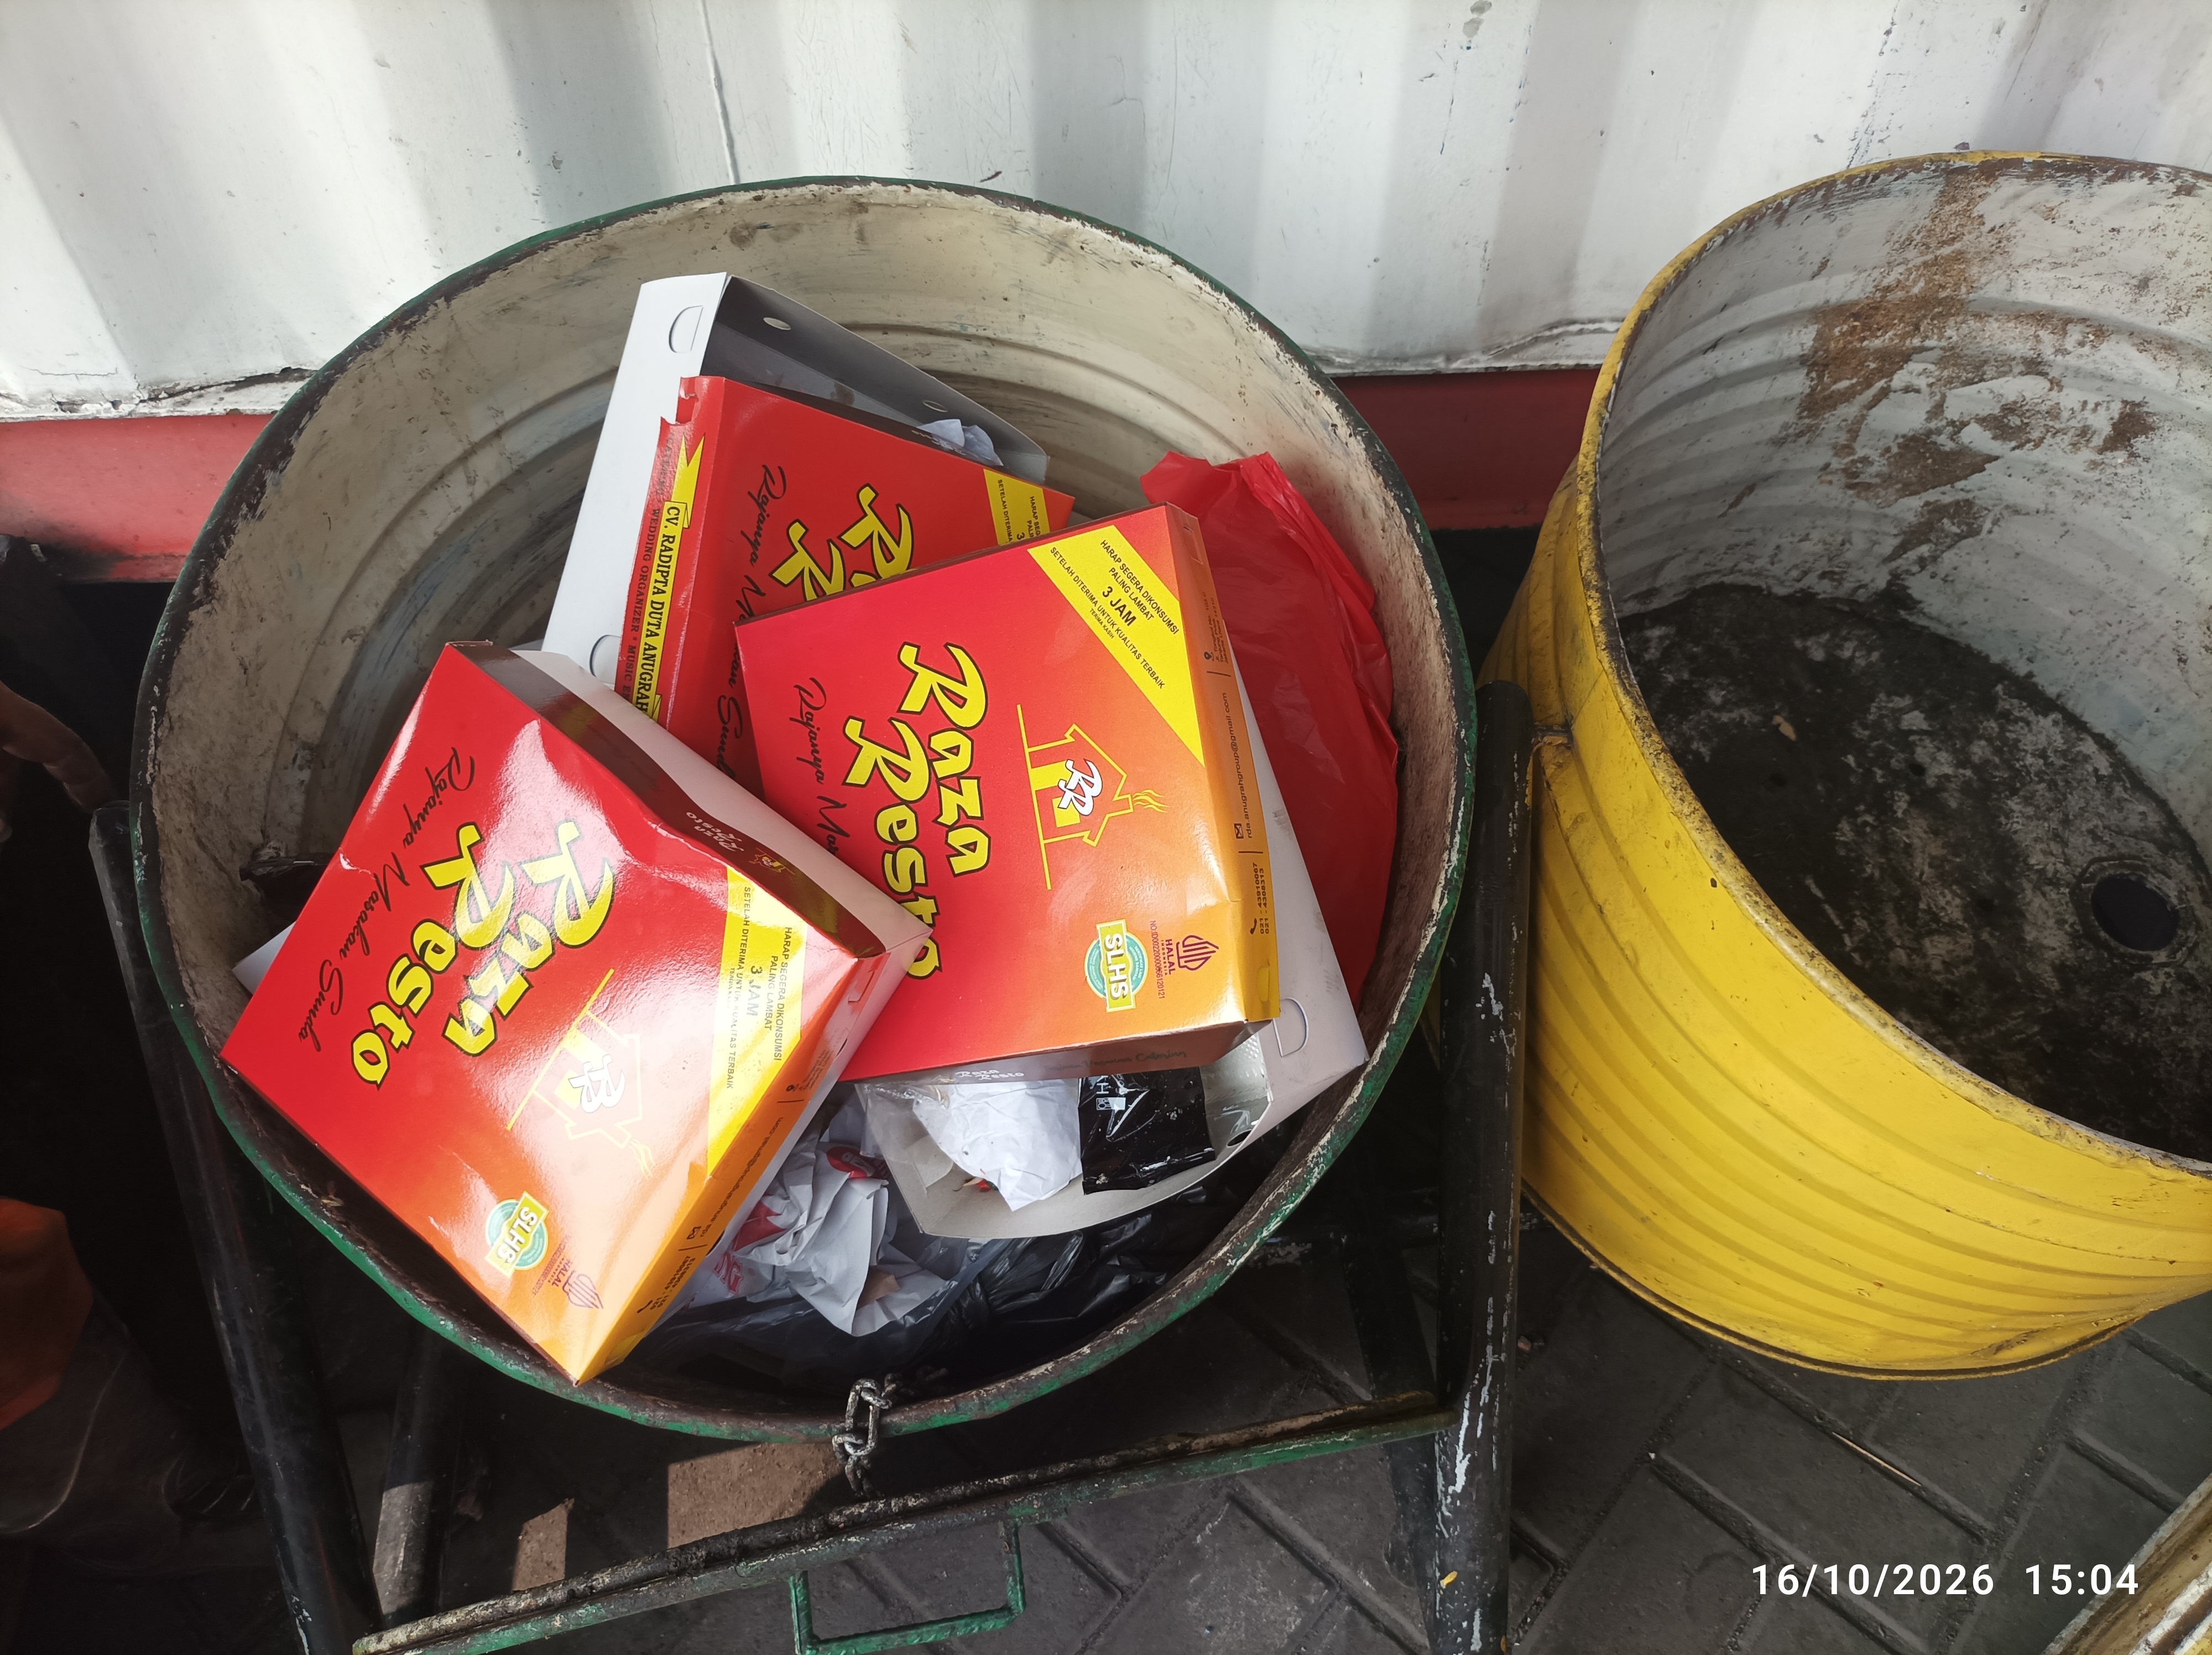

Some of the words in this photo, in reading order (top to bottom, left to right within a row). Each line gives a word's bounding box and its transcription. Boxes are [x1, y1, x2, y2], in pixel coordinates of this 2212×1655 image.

[664, 506, 680, 529] CV.
[740, 464, 786, 567] Rajanya
[998, 480, 1007, 509] SETELAH
[1004, 511, 1013, 543] DITERIMA
[1030, 496, 1039, 520] HARAP
[643, 508, 660, 562] WEDDING
[1016, 532, 1025, 540] 3
[652, 533, 676, 596] RADIPTA
[1100, 540, 1121, 563] HARAP
[1120, 563, 1143, 594] SEGERA
[1142, 591, 1179, 635] DIKONSUMSI
[631, 565, 649, 632] ORGANIZER
[644, 600, 665, 638] DUTA
[1051, 547, 1075, 577] SETELAH
[1073, 575, 1098, 607] DITERIMA
[1097, 605, 1117, 629] UNTUK
[1115, 627, 1142, 660] KUALITAS
[1140, 658, 1165, 689] TERBAIK
[1102, 586, 1113, 598] 3
[1110, 598, 1136, 626] JAM
[1109, 567, 1130, 594] PALING
[1129, 592, 1155, 621] LAMBAT
[1089, 608, 1103, 627] TERIMA
[1102, 624, 1115, 639] KASIH
[624, 644, 637, 682] MUSIC
[635, 642, 658, 713] ANUGRAH
[790, 677, 826, 785] Rajanya
[898, 641, 992, 876] Raza
[1223, 693, 1253, 839] rda.anugrahgroup@gmail.com
[403, 746, 476, 849] Rajanya
[686, 812, 742, 842] Resto
[694, 826, 744, 852] Raza
[842, 715, 942, 980] Resto
[339, 852, 410, 960] Masakan
[1253, 862, 1262, 908] 43910067
[351, 822, 517, 1089] Resto
[443, 819, 614, 1056] Raza
[737, 929, 749, 970] DITERIMA
[781, 927, 792, 960] HARAP
[1165, 939, 1176, 975] HALAL
[750, 965, 763, 975] 3
[768, 955, 779, 989] PALING
[778, 961, 788, 1003] SEGERA
[1105, 933, 1129, 1000] SLHS
[298, 959, 343, 1052] Sunda
[747, 979, 761, 1017] JAM
[764, 990, 774, 1031] LAMBAT
[774, 1003, 785, 1061] DIKONSUMSI
[727, 1050, 736, 1089] TERBAIK
[955, 1069, 999, 1078] Raza
[498, 1206, 538, 1263] SLHS
[552, 1258, 573, 1287] HALAL
